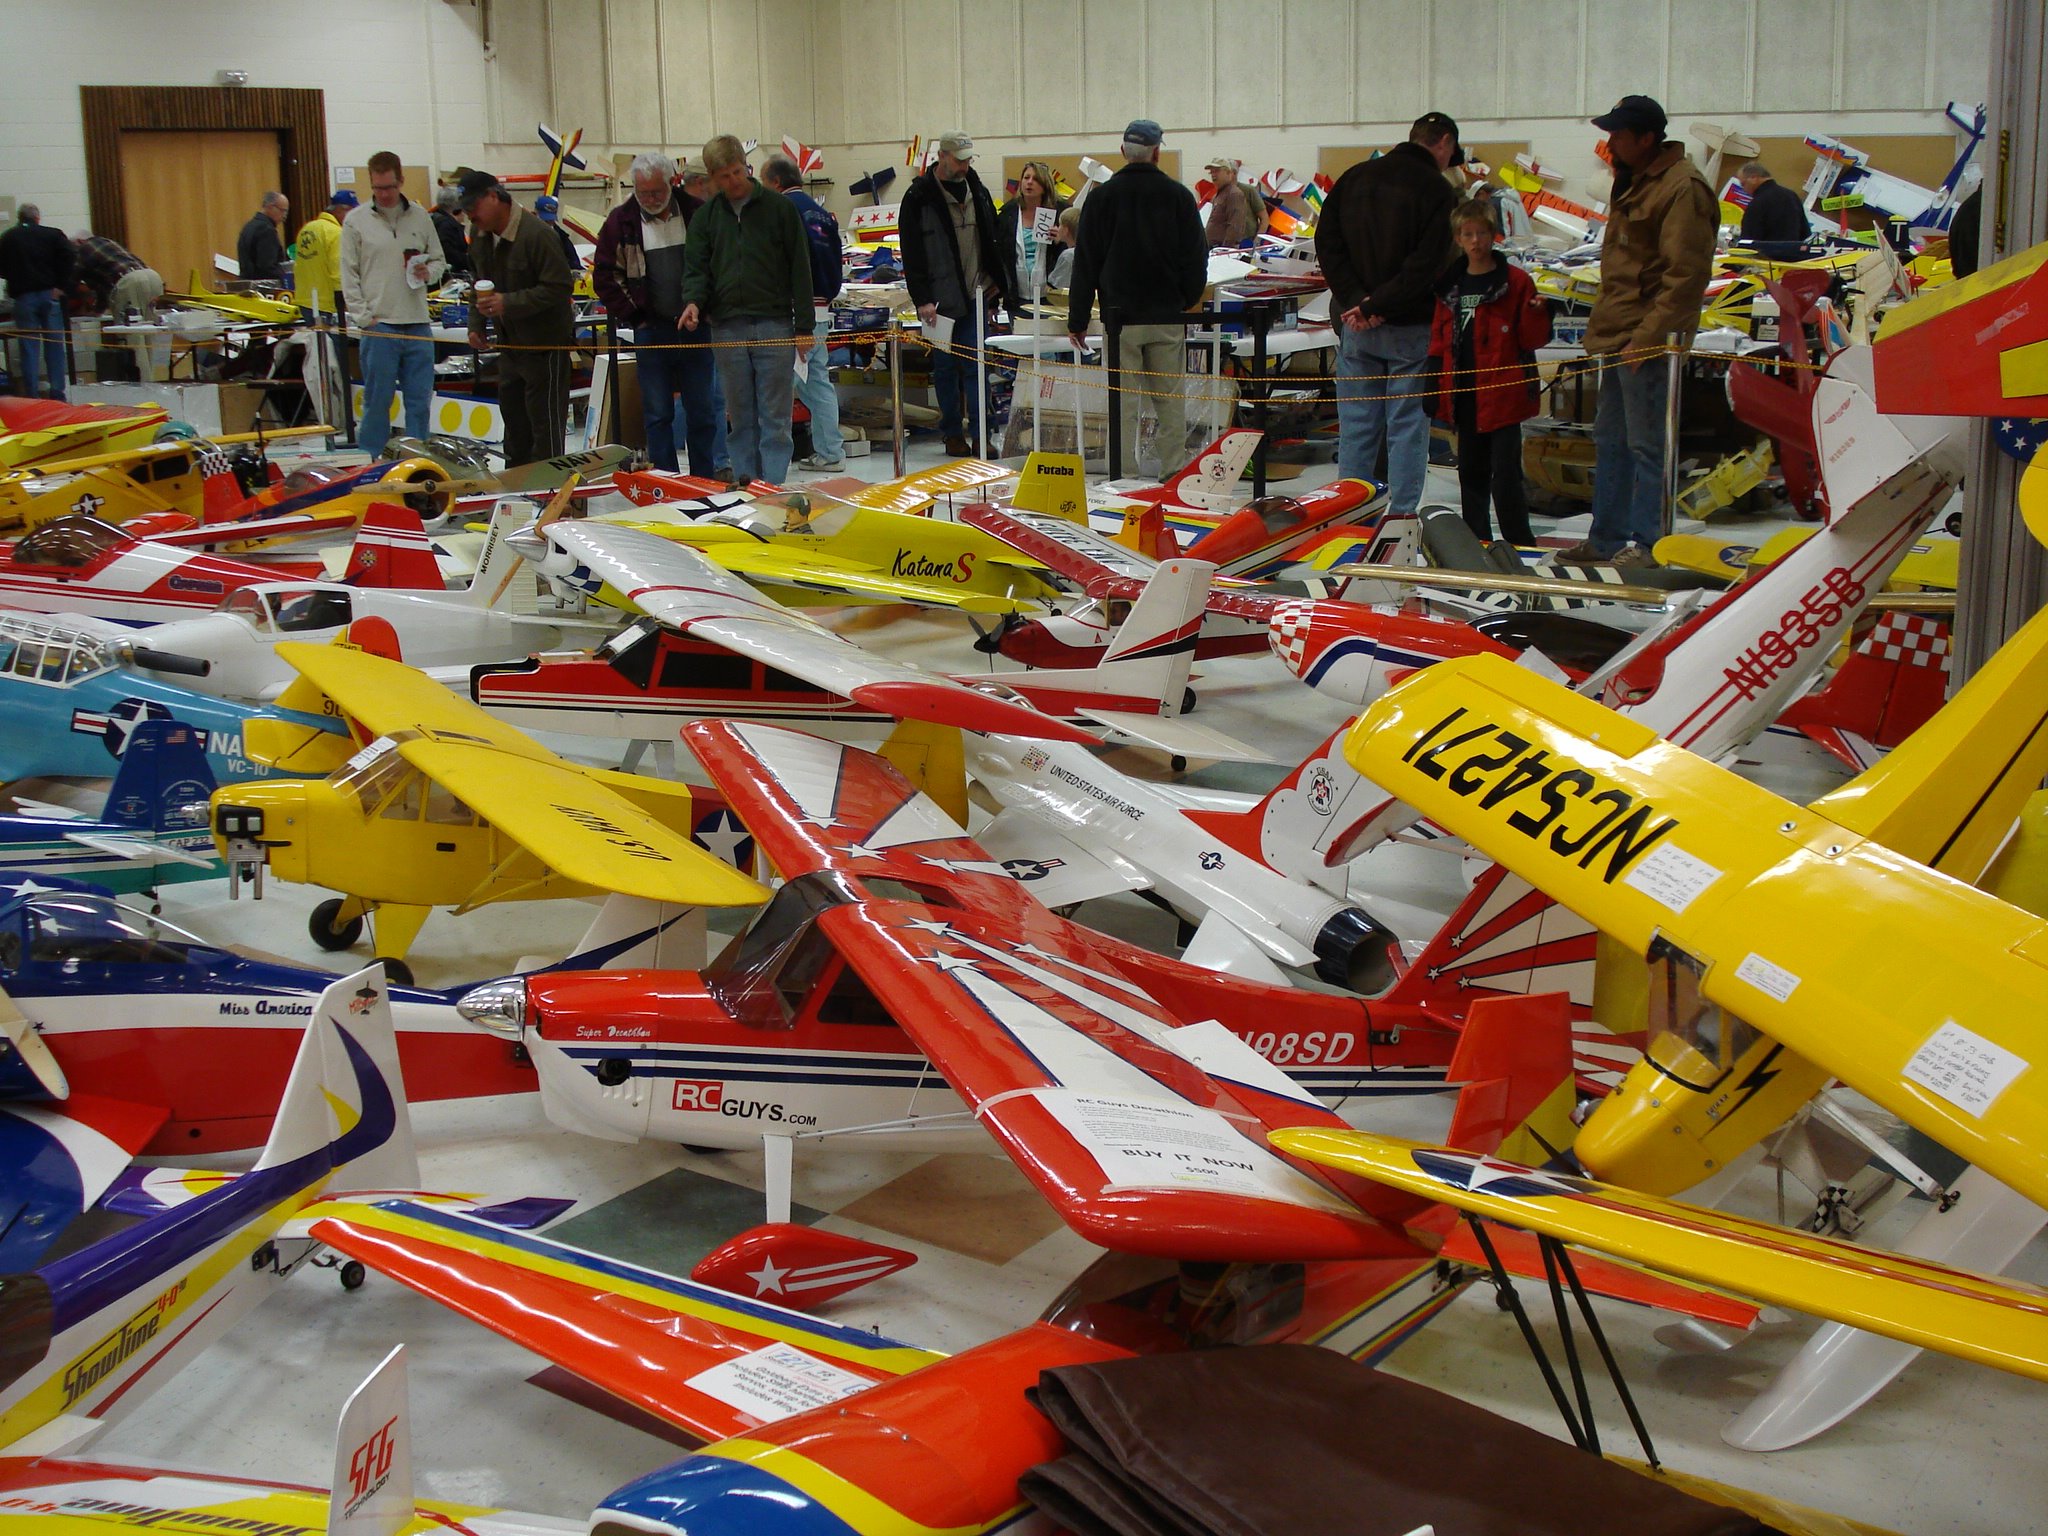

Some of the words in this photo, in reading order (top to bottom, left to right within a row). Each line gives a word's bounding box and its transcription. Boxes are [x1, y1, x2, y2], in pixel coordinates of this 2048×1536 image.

[548, 450, 604, 471] NAVY
[1037, 464, 1075, 476] Futaba
[480, 523, 500, 575] MORRISEY
[228, 758, 270, 777] VC-10
[1050, 764, 1080, 786] UNITED
[1076, 780, 1107, 801] STATES
[1102, 794, 1119, 809] AIR
[1117, 801, 1145, 821] FORCE
[219, 1002, 250, 1016] Miss
[255, 1000, 313, 1016] America
[576, 1025, 602, 1039] Super
[674, 1082, 722, 1110] RC
[1122, 1149, 1163, 1159] BUY
[1174, 1153, 1192, 1162] IT
[1203, 1156, 1255, 1172] NOW
[344, 1415, 398, 1509] SFG
[344, 1471, 391, 1520] TECHNOLOGY
